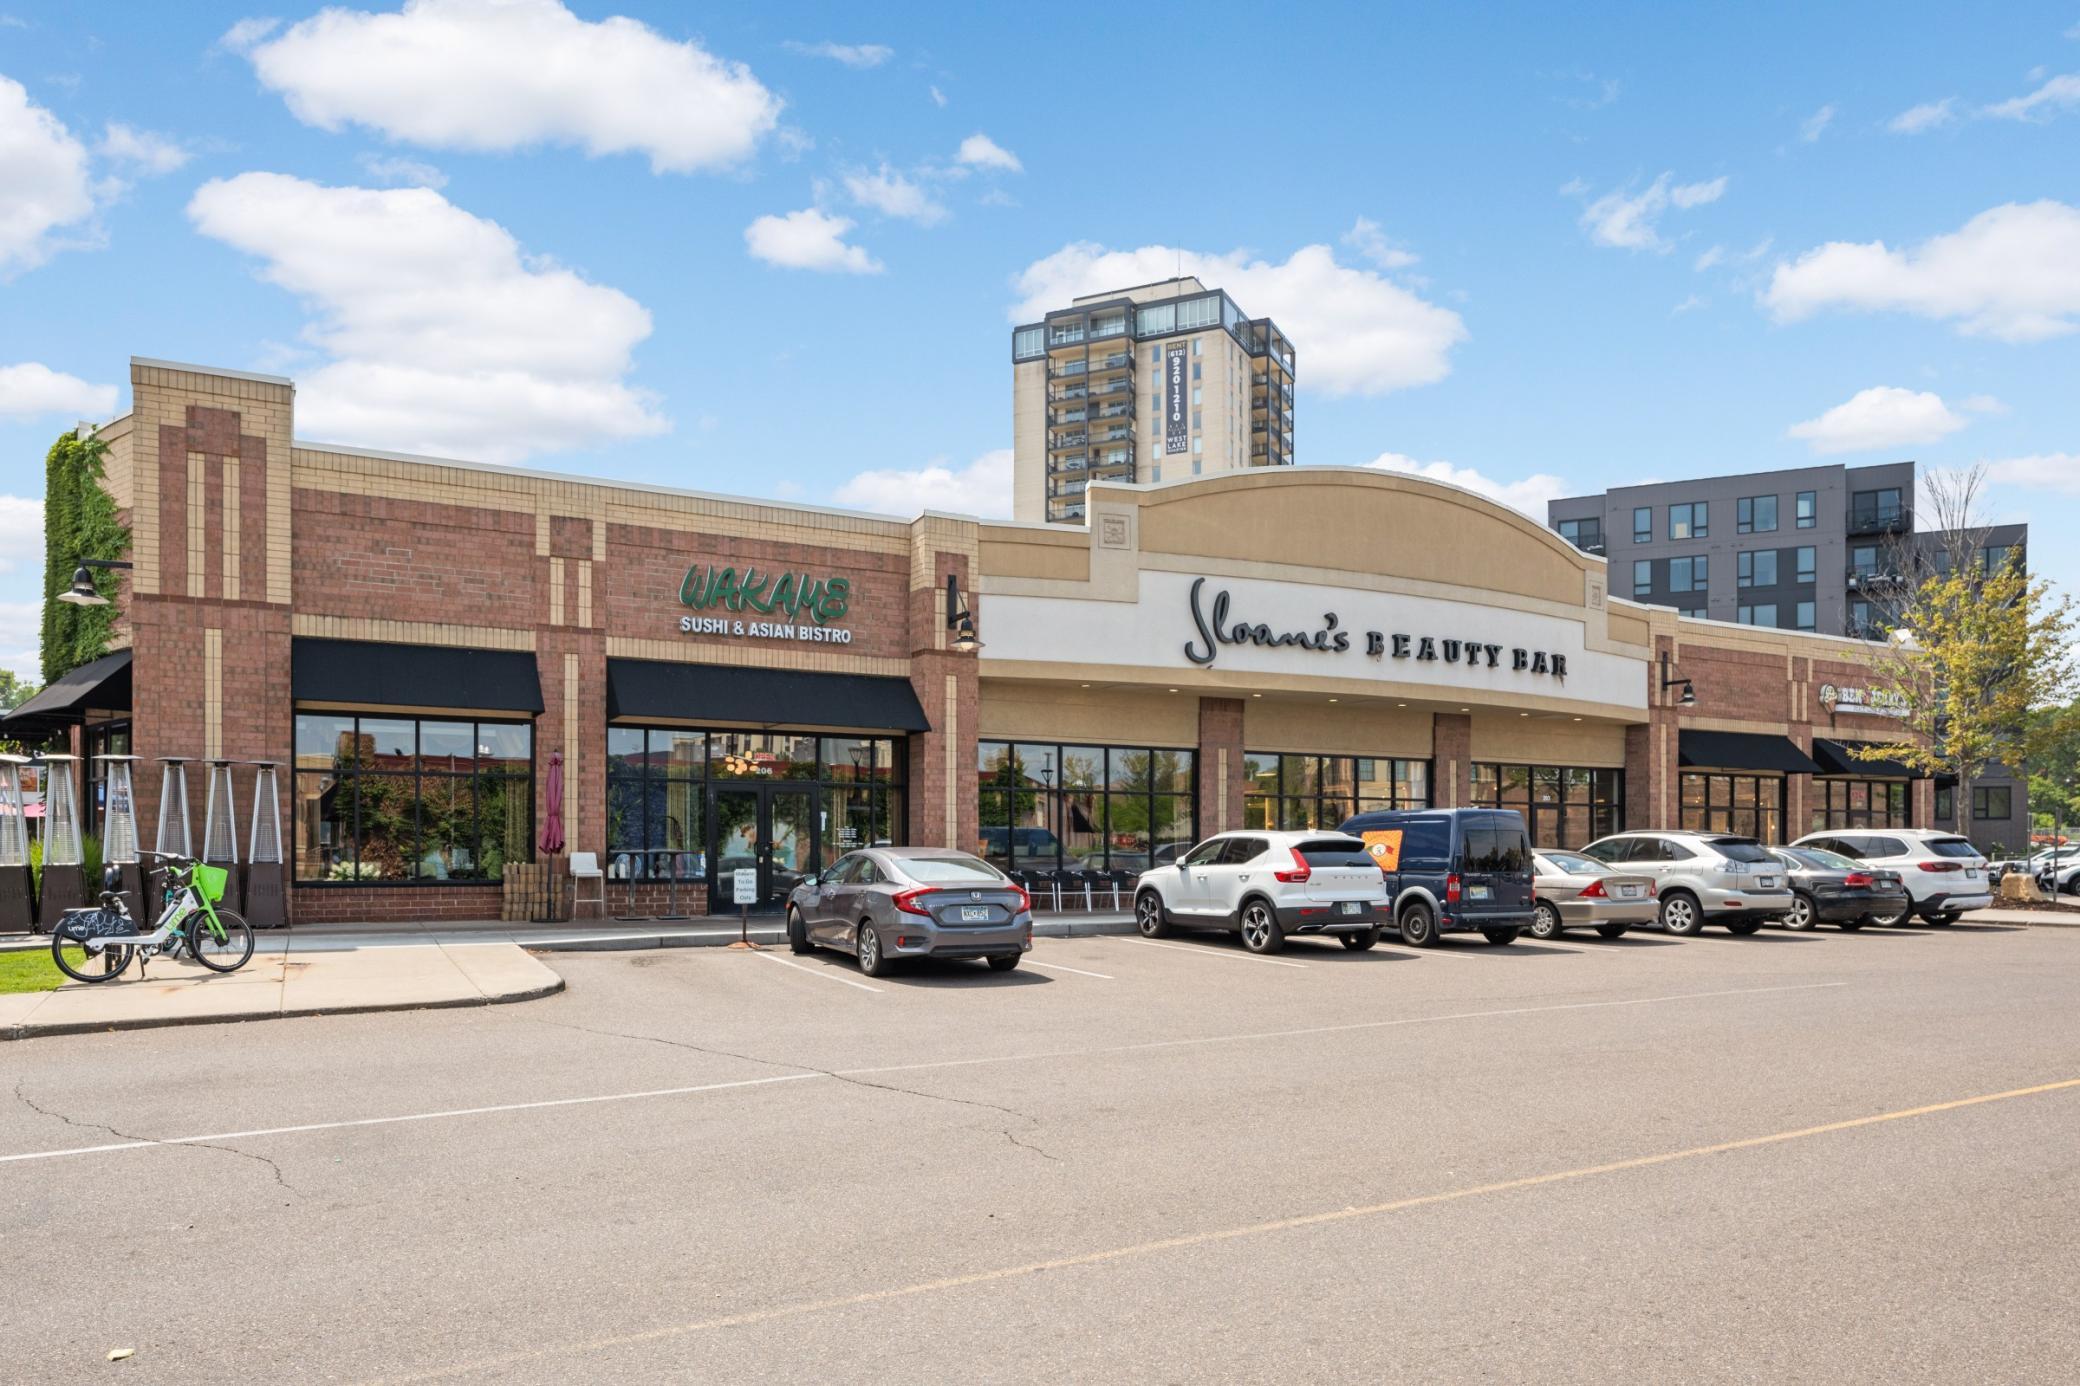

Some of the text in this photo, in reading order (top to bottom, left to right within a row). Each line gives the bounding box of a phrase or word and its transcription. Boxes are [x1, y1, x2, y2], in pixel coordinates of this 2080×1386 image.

[1167, 349, 1186, 358] (612)
[1167, 435, 1187, 443] WEST
[1167, 441, 1186, 449] LAKE
[679, 564, 850, 625] WAKAME
[679, 616, 851, 644] SUSHI & ASIAN BISTRO
[1184, 577, 1568, 676] Sloane's BEAUTY BAR
